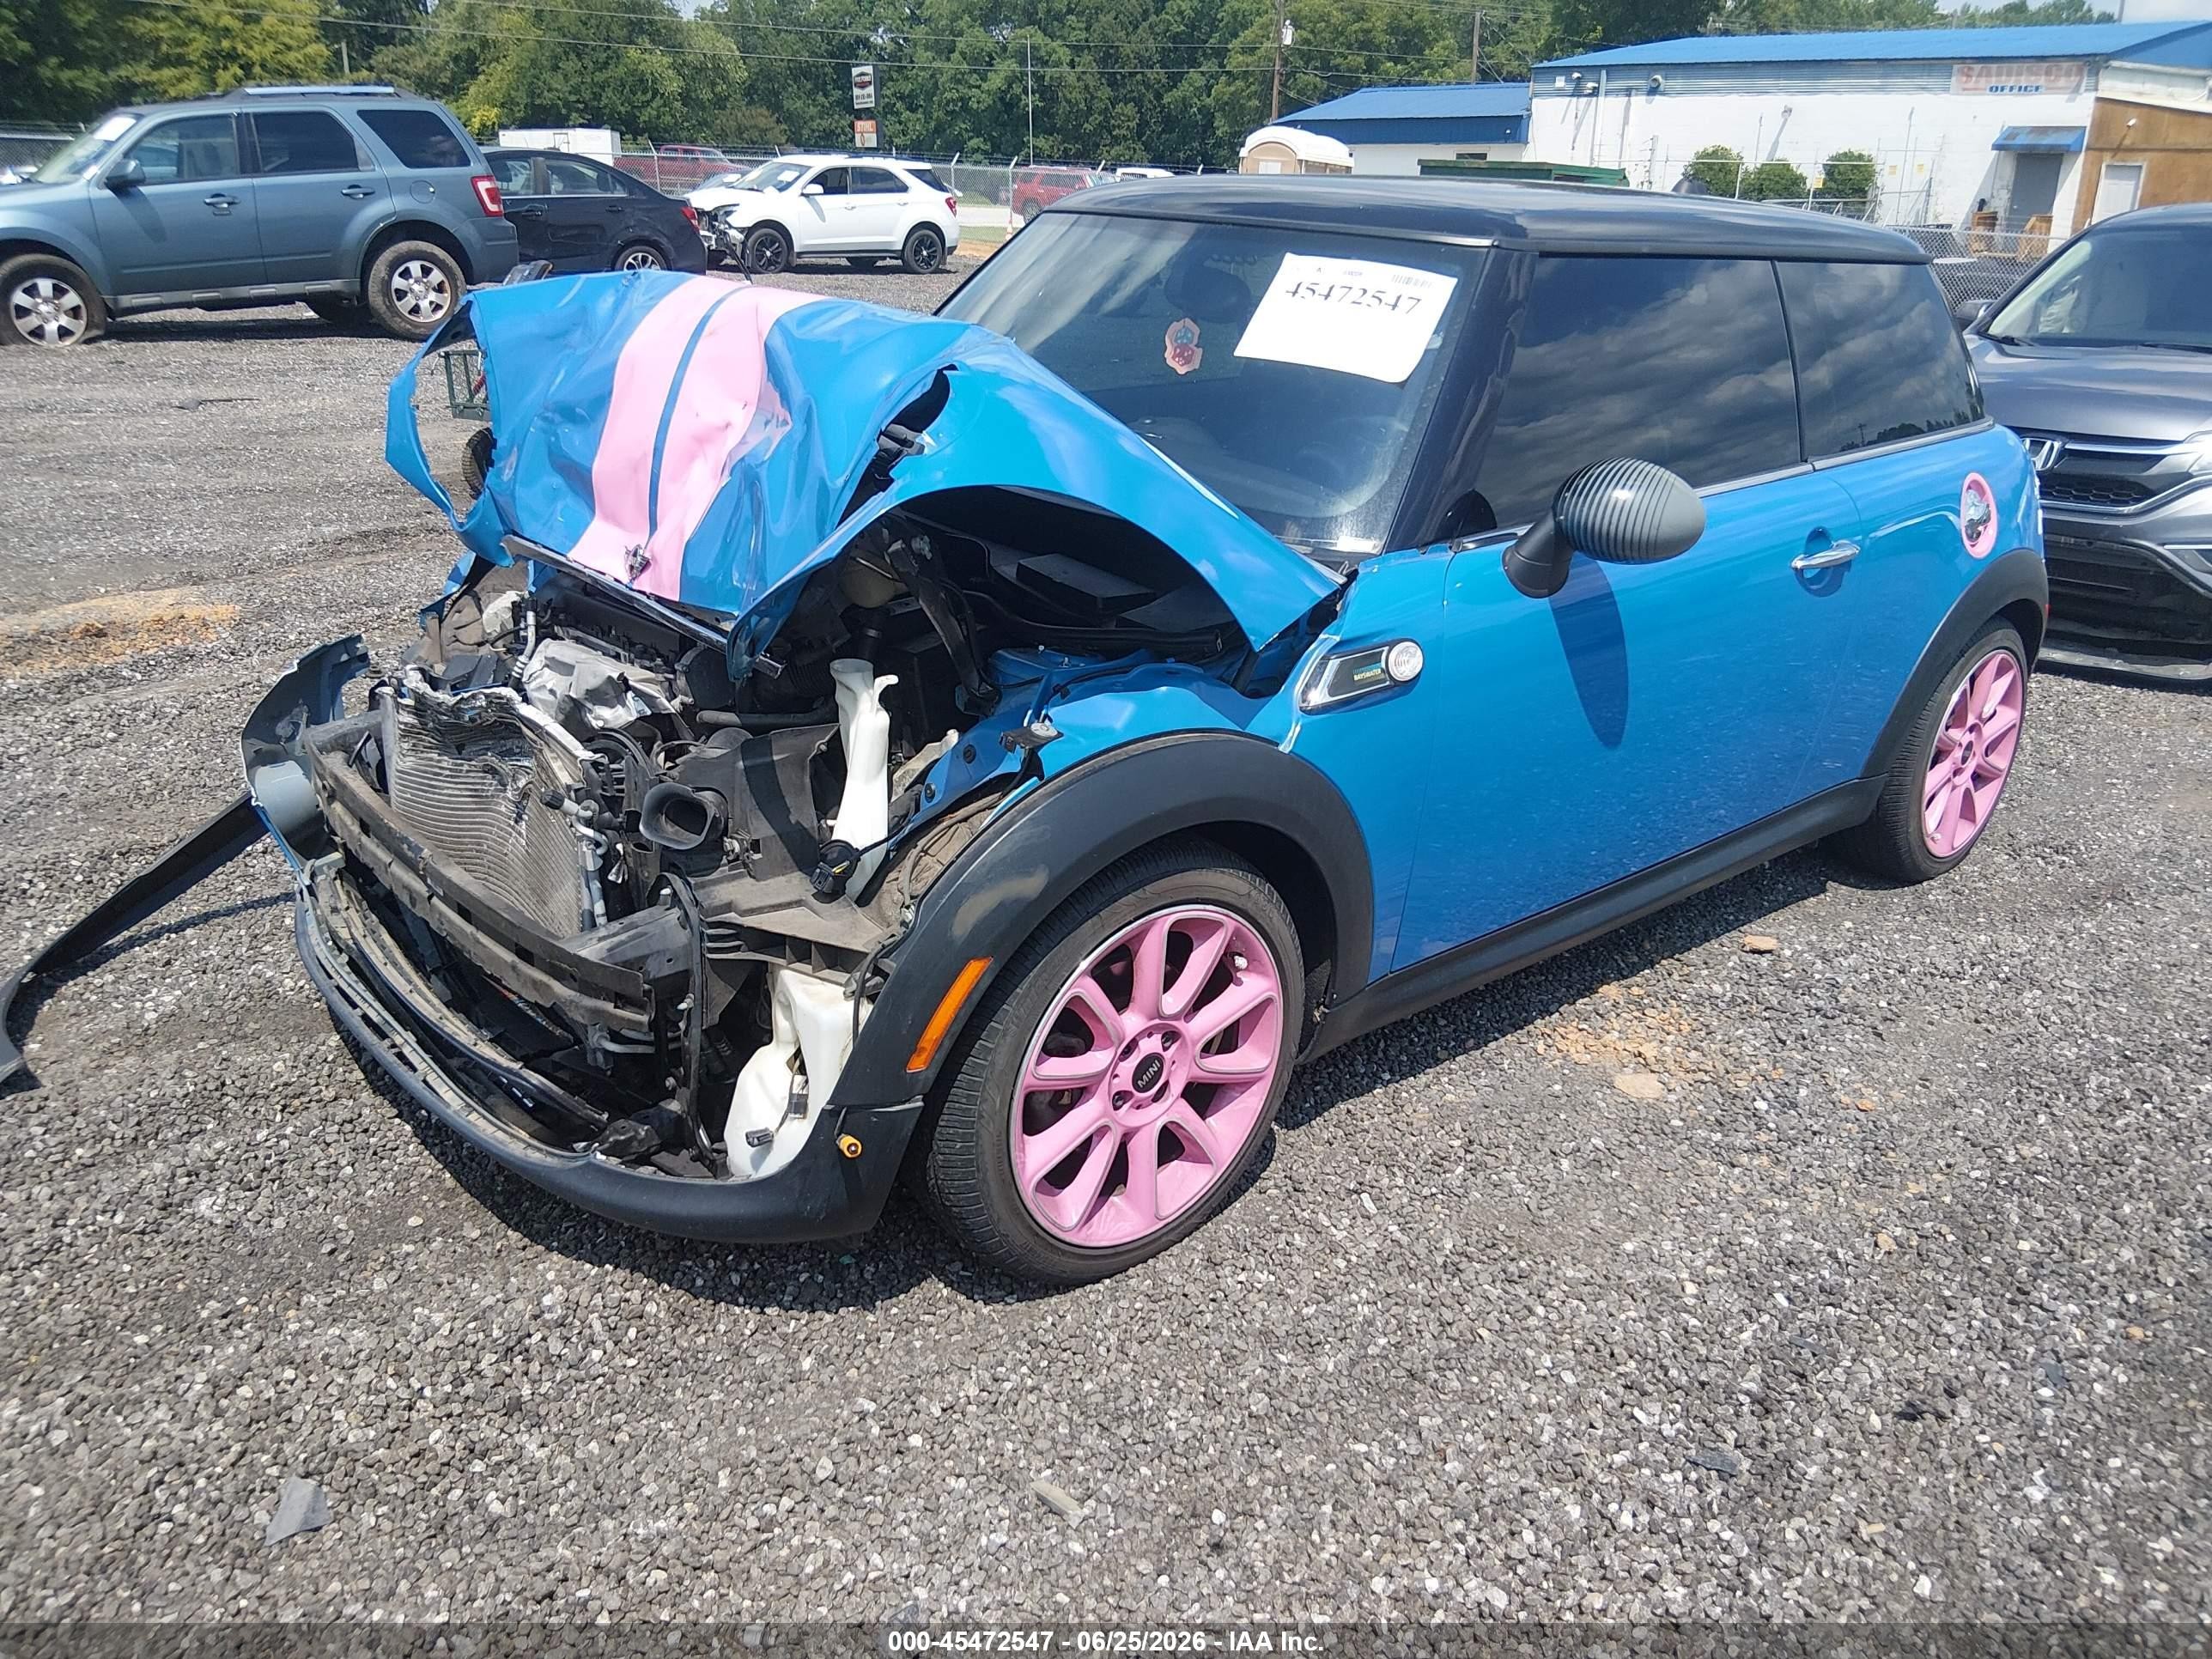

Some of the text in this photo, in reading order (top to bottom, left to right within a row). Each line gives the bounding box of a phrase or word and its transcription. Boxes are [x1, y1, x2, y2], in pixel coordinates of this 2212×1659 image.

[1988, 84, 2044, 94] OFFICE
[1285, 281, 1422, 314] 45472547
[1353, 668, 1382, 681] BAYSWATER
[1137, 1060, 1161, 1088] MINI
